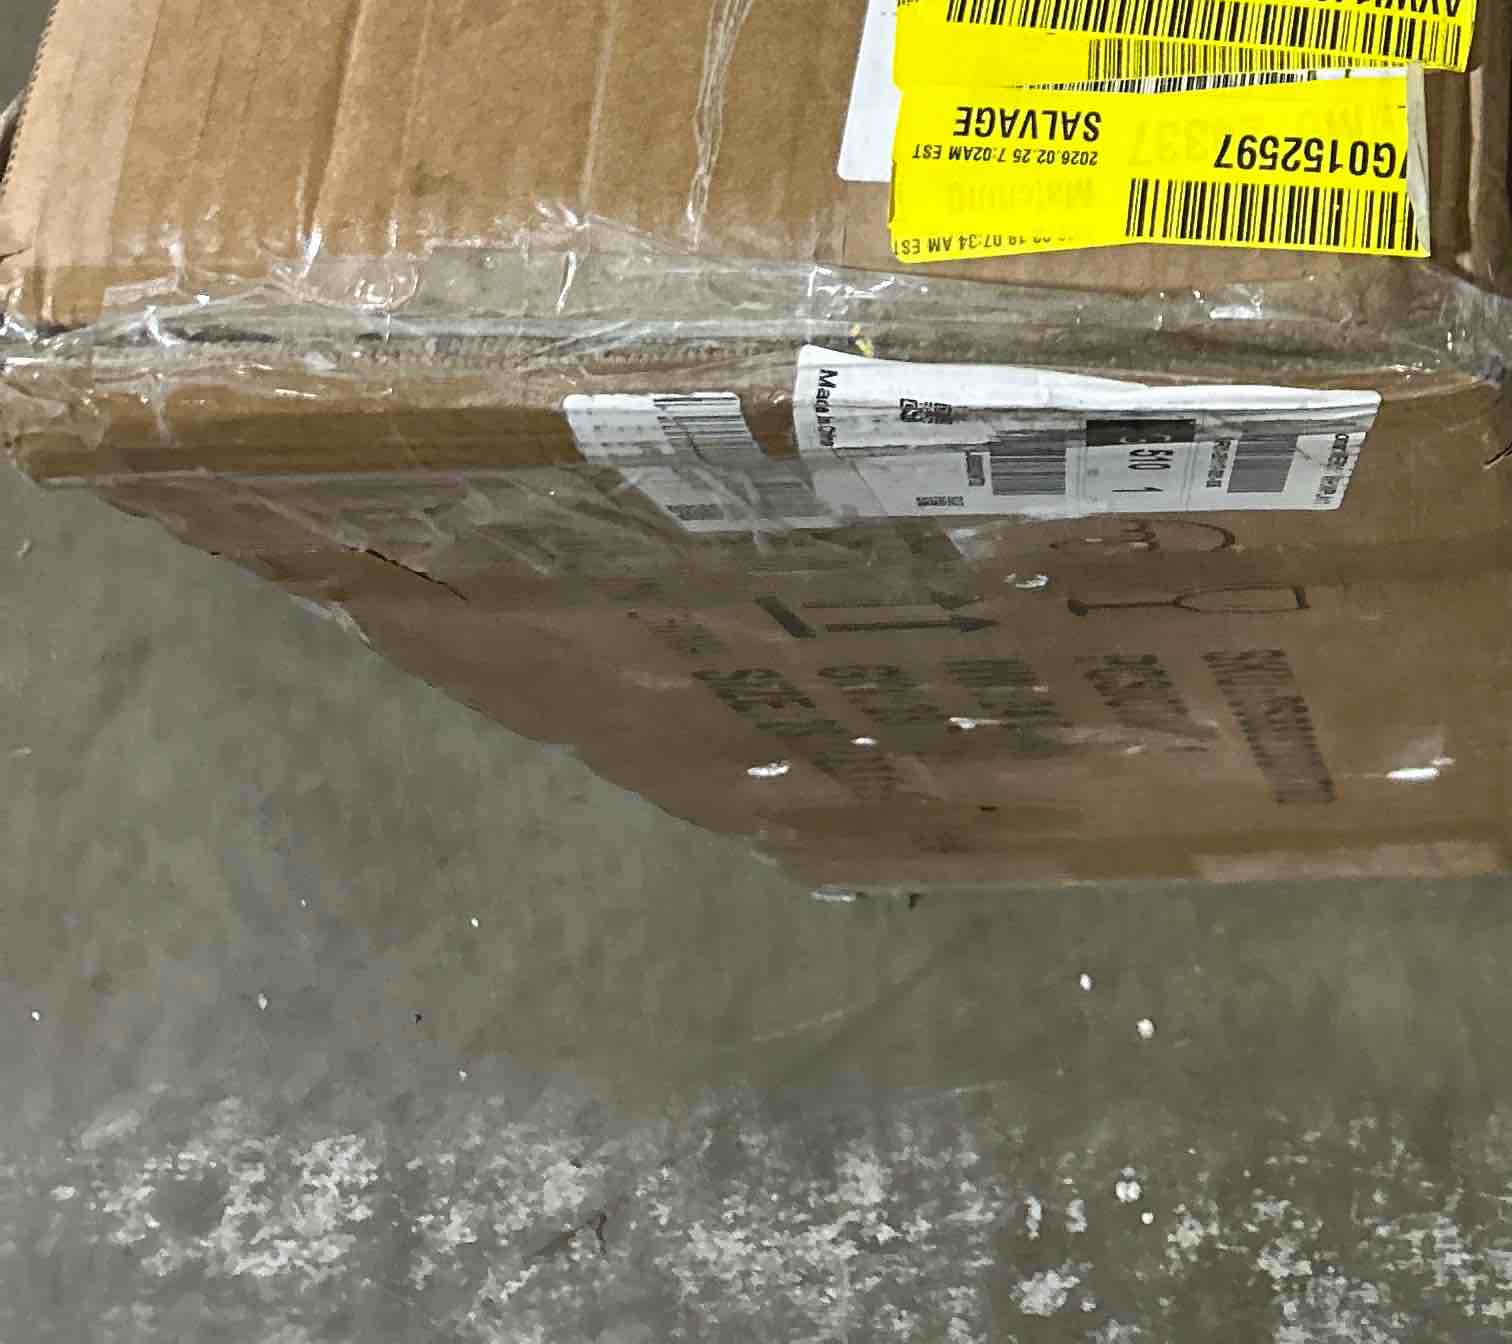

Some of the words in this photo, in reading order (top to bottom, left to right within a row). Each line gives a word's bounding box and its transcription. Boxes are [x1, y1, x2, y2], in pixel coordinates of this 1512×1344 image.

[952, 105, 1102, 142] SALVAGE
[912, 144, 943, 161] EST
[948, 145, 1009, 164] 7:02AM
[1013, 147, 1099, 167] 2026.02.25
[926, 236, 954, 253] AM
